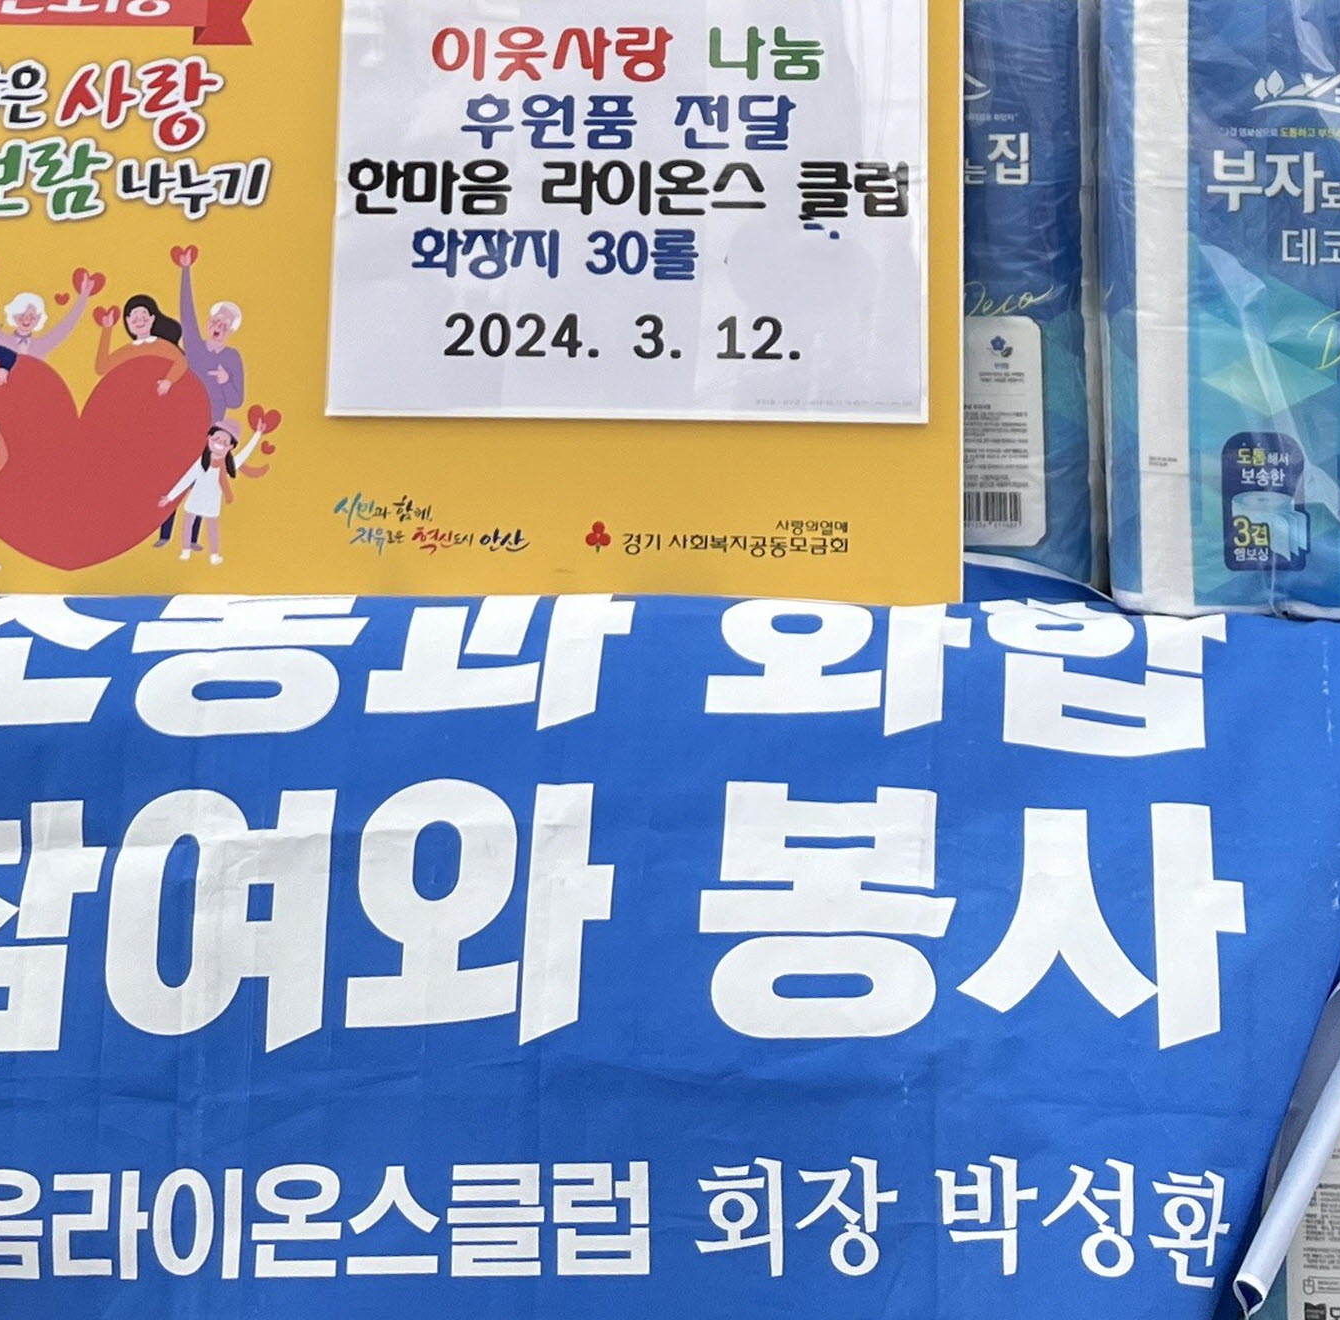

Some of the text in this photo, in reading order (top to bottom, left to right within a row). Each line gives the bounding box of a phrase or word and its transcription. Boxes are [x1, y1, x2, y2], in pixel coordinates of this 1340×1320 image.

[432, 25, 825, 82] 이웃사랑 나눔
[59, 57, 222, 147] 사랑
[460, 93, 797, 151] 후원품 전달
[118, 160, 269, 218] 나누기
[347, 157, 910, 219] 한마음 라이온스 클럽
[411, 227, 700, 281] 화장지 30롤
[443, 312, 802, 361] 2024. 3. 12.
[1240, 467, 1286, 488] 보송한
[412, 527, 474, 555] 혁신도시
[479, 528, 531, 552] 안산
[622, 532, 849, 558] 경기 사회복지공동모금회
[1232, 516, 1270, 547] 3겹
[1233, 546, 1270, 563] 엠보싱
[699, 780, 1246, 1051] 봉사
[695, 1154, 899, 1278] 회장
[934, 1152, 1233, 1289] 박성환
